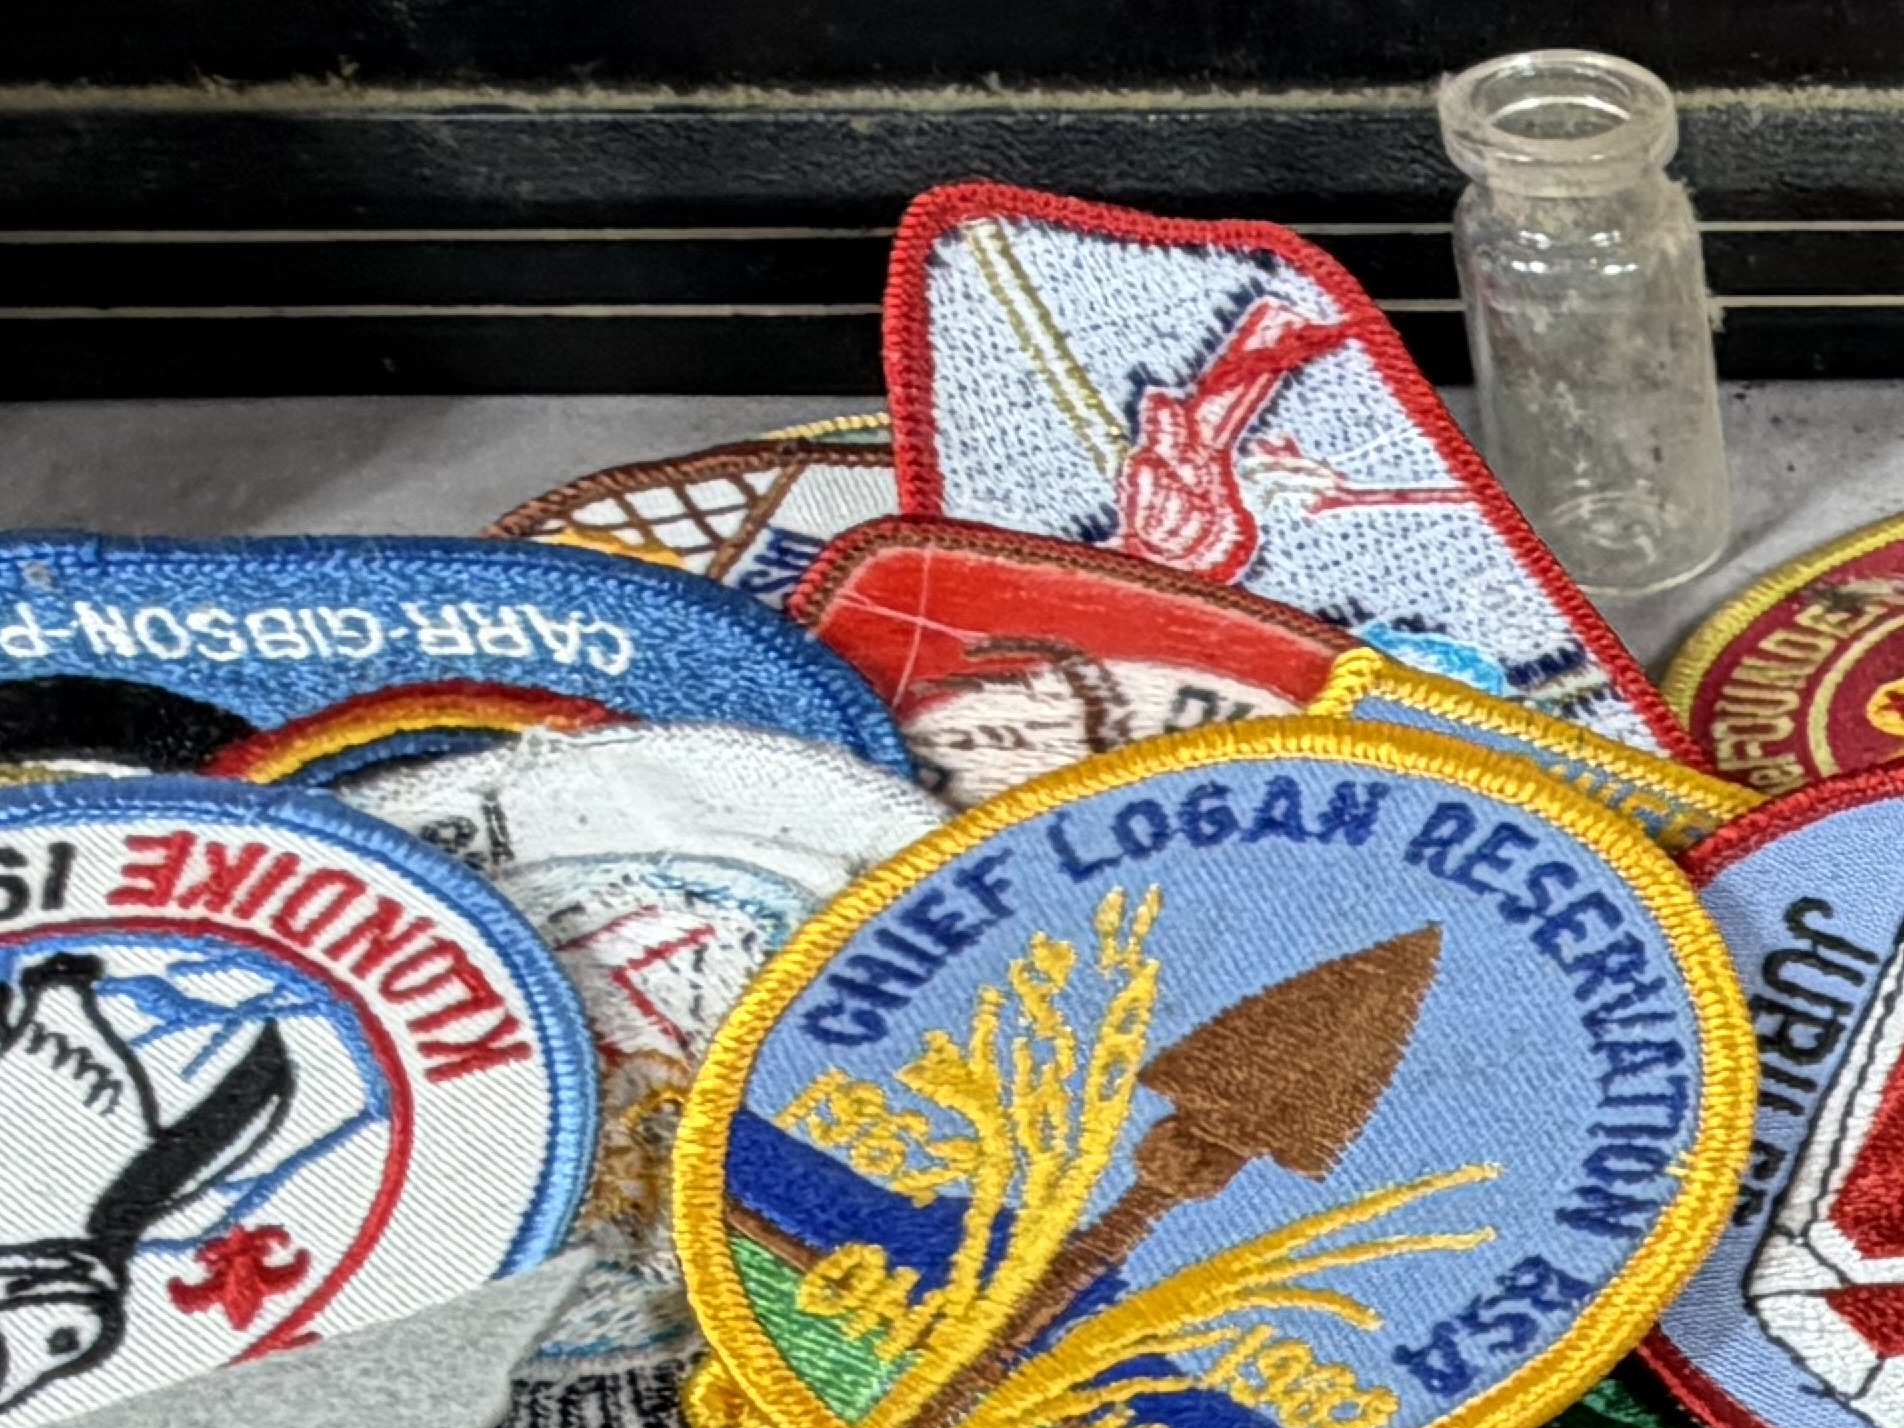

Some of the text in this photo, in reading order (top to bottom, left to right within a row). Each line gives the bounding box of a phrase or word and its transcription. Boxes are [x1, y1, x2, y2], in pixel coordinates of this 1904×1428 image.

[104, 828, 534, 1084] KLONDIKE
[808, 853, 1017, 1048] CHIEF
[1052, 774, 1392, 884] LOGAN
[1402, 801, 1692, 1244] RESERVATION
[1389, 1252, 1596, 1397] BSA
